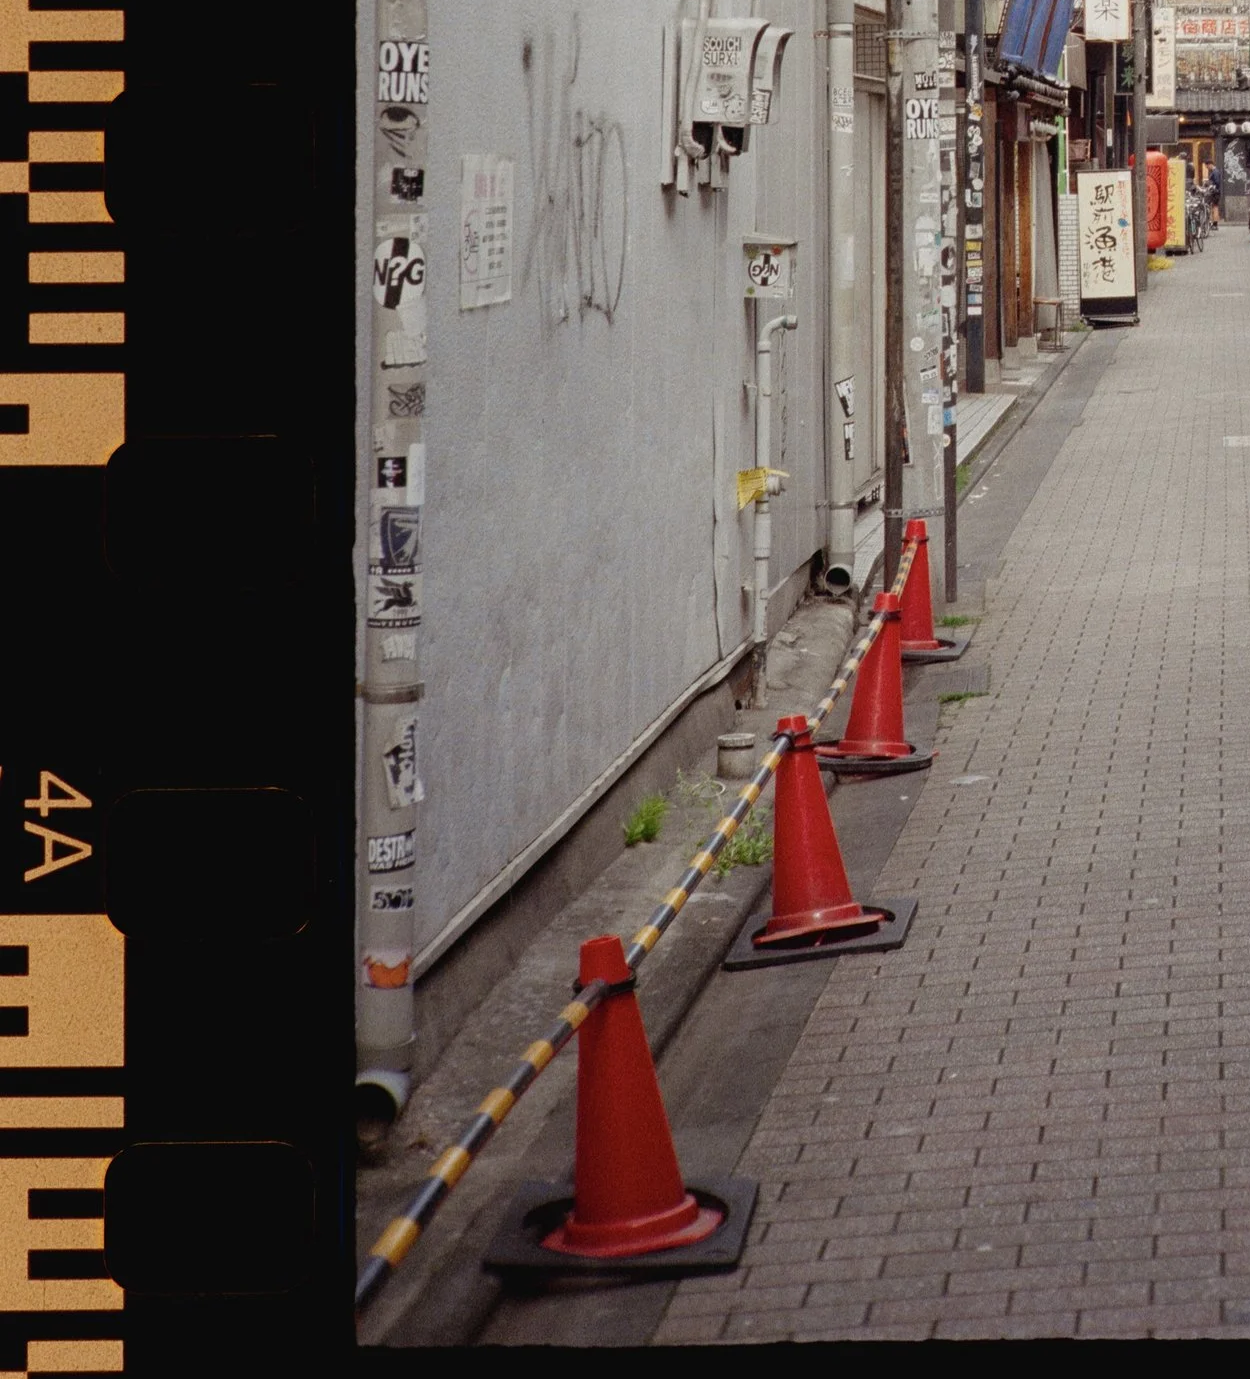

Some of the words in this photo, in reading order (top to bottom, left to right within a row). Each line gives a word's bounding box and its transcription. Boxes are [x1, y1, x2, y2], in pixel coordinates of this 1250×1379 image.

[380, 42, 429, 72] OYE
[379, 72, 429, 103] RUNS
[906, 99, 938, 119] OYE
[907, 119, 938, 139] RUNS
[24, 770, 92, 883] 4A
